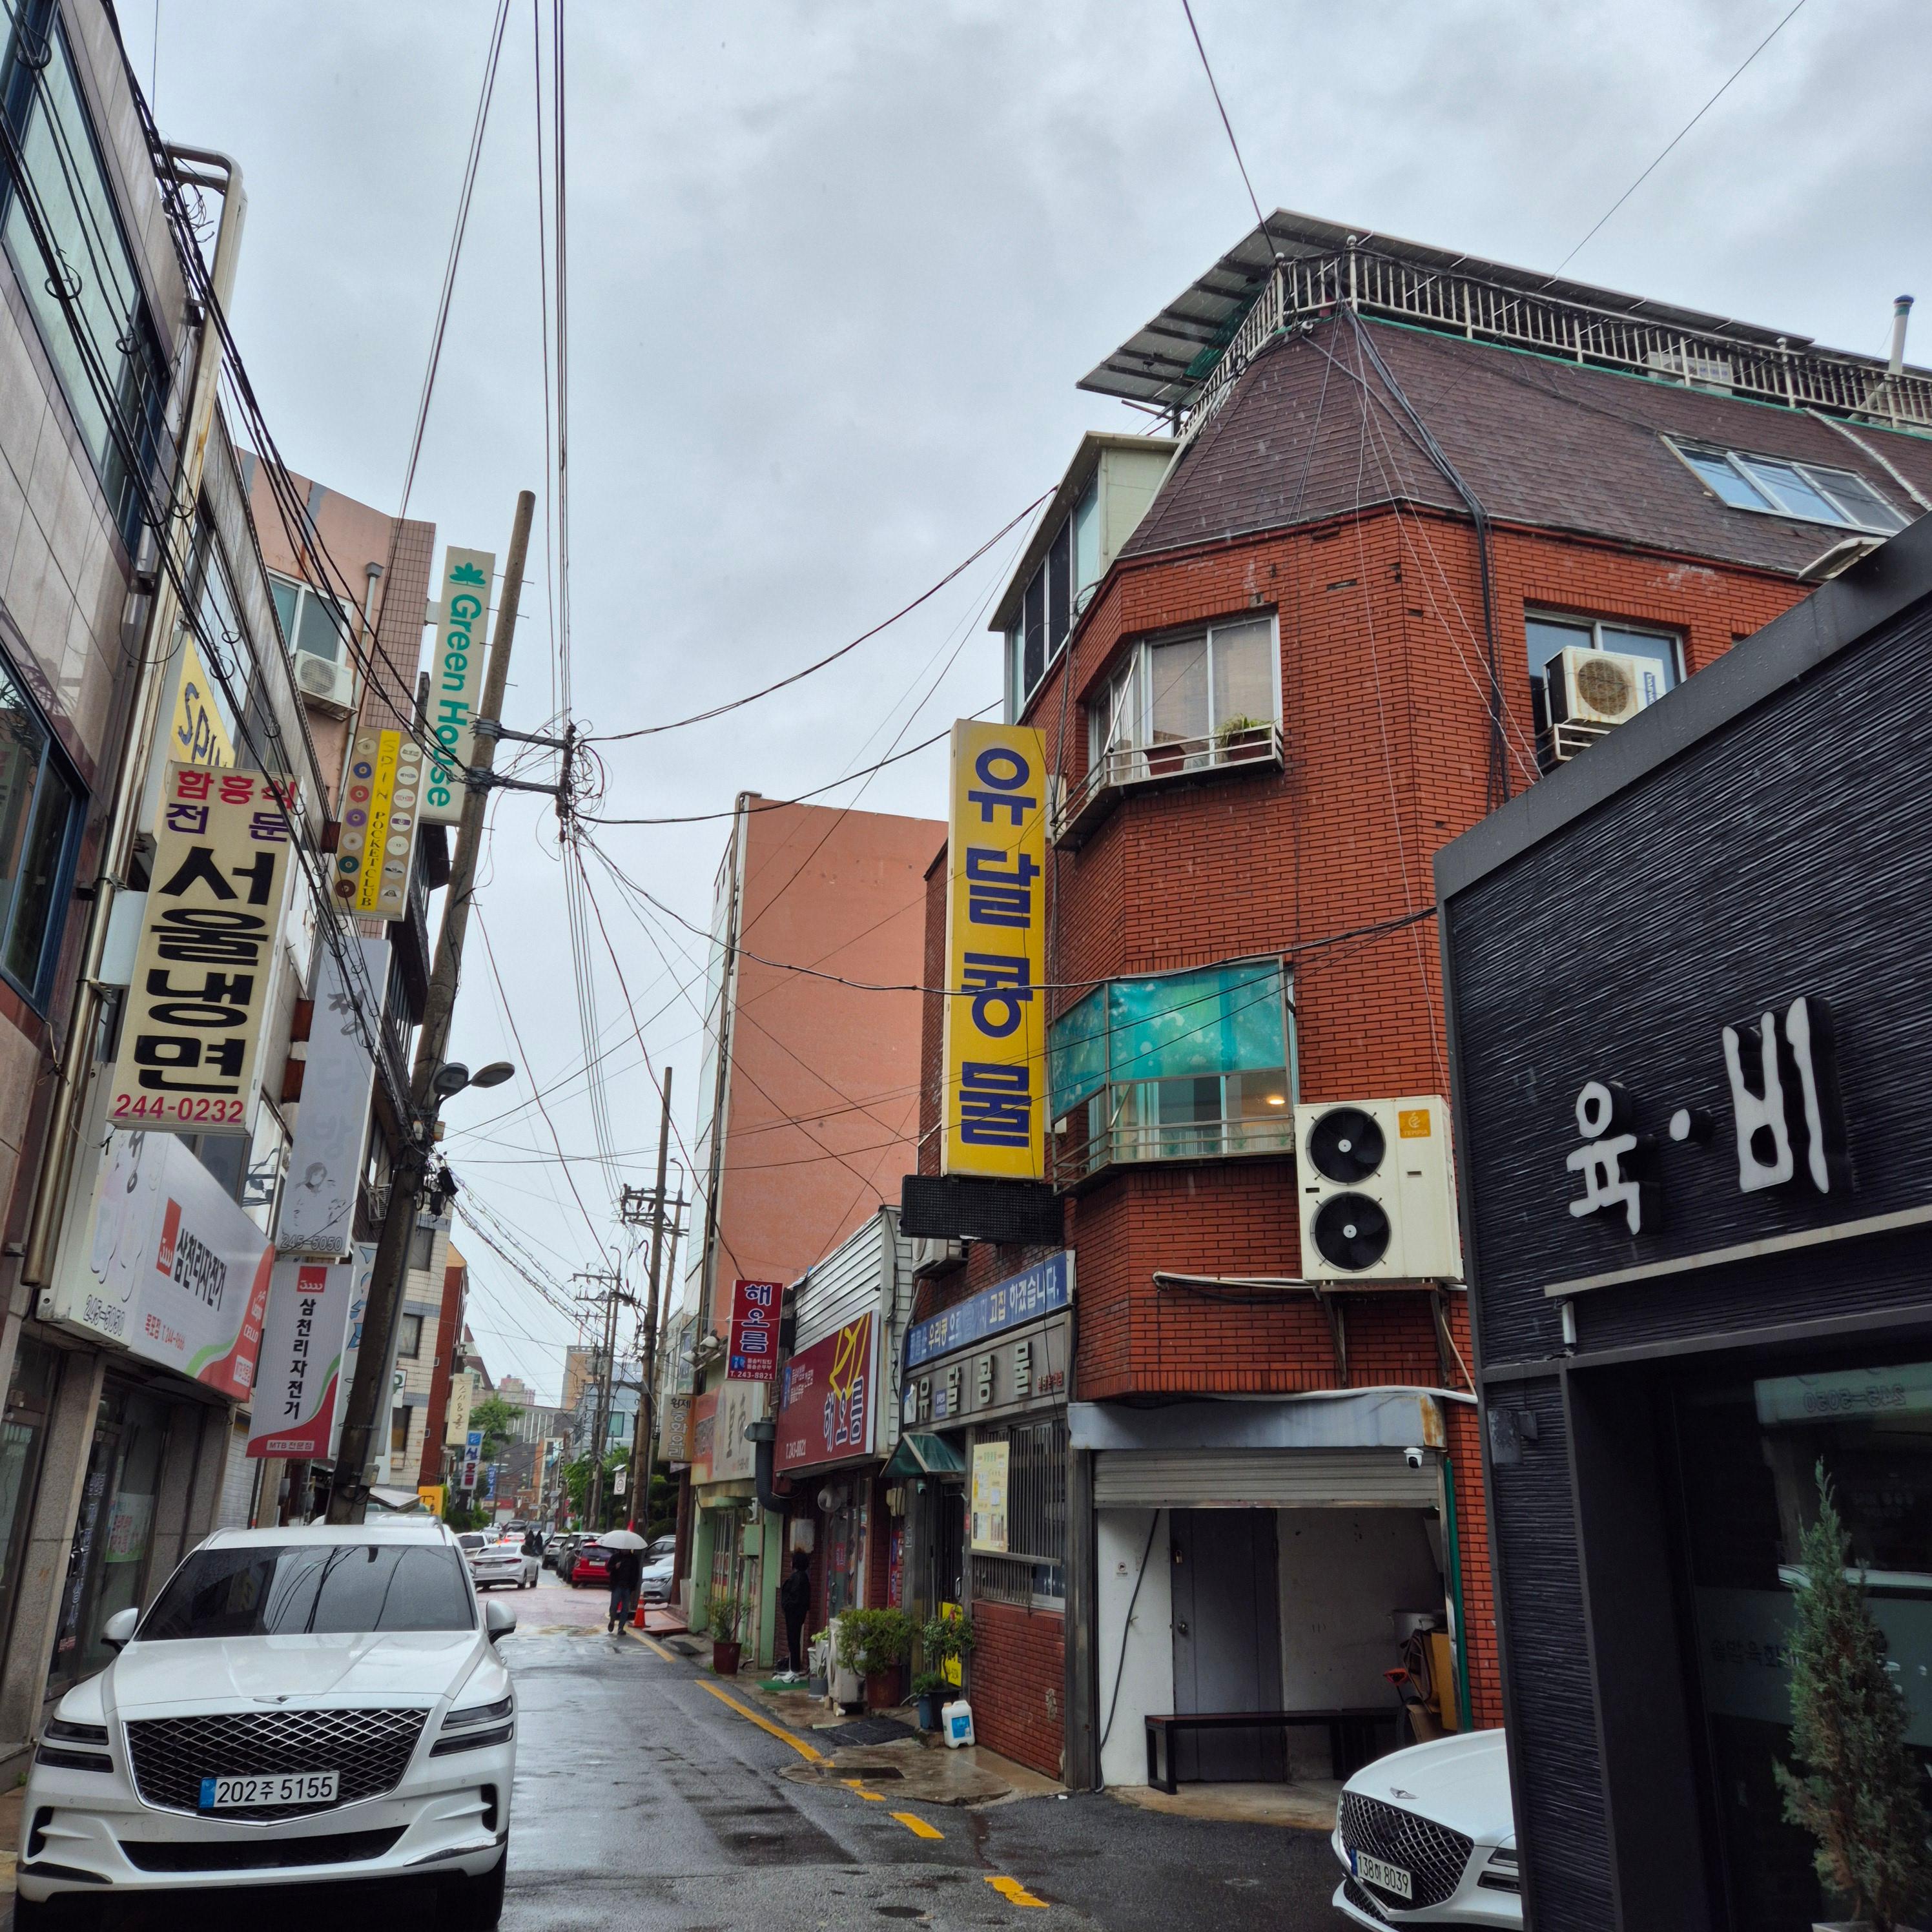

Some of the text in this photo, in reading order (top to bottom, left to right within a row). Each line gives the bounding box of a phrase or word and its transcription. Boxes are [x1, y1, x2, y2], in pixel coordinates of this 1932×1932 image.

[427, 594, 482, 807] Green House
[177, 769, 296, 809] 함흥식
[167, 803, 288, 842] 전문
[369, 812, 385, 866] POCKET
[362, 868, 376, 906] CLUB
[134, 846, 275, 1094] 서울냉면
[959, 748, 1040, 1147] 유달콩물
[114, 1094, 244, 1123] 244-0232
[280, 1233, 343, 1251] 245-5050
[174, 1228, 227, 1312] 삼천리자전거
[83, 1293, 125, 1337] 245-5050
[741, 1284, 774, 1354] 해오름
[929, 1317, 948, 1351] 우리콩
[989, 1290, 1006, 1324] 고집
[283, 1298, 316, 1421] 삼천리자전거
[737, 1370, 774, 1381] 243-8821
[918, 1341, 1031, 1421] 유달콩물
[823, 1375, 864, 1452] 해오름
[288, 1441, 312, 1450] 전문점
[217, 1776, 333, 1803] 202주 5155
[1384, 1865, 1409, 1893] 8039
